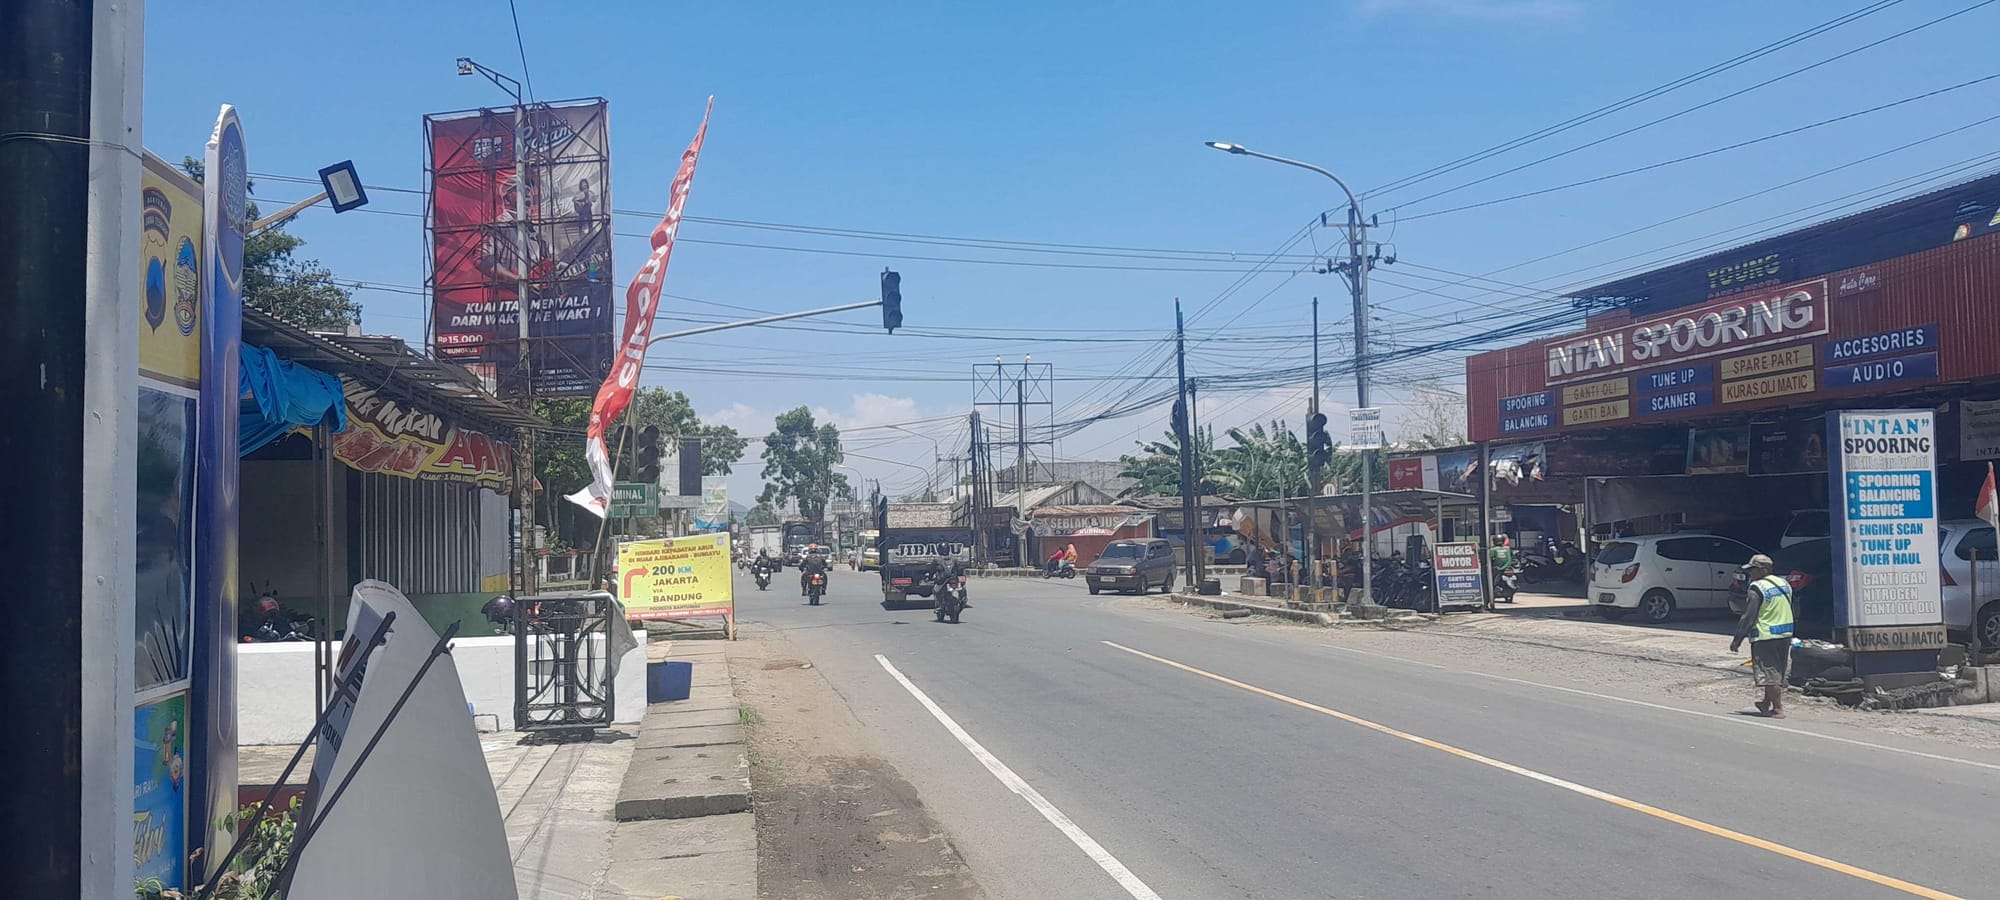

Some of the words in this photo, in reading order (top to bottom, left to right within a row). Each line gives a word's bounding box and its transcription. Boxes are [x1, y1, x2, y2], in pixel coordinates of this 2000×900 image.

[1708, 254, 1780, 289] YOUNG
[465, 300, 520, 314] KUALITA
[530, 295, 590, 310] MENYALA
[451, 314, 481, 327] DARI
[1550, 332, 1625, 377] INTAN
[1632, 290, 1814, 361] SPOORING
[1833, 329, 1924, 358] ACCESORIES
[1733, 355, 1769, 375] SPARE
[1771, 351, 1800, 369] PART
[1651, 370, 1676, 388] TUNE
[1680, 368, 1695, 384] UP
[1852, 361, 1904, 383] AUDIO
[1573, 384, 1598, 399] GANTI
[1602, 381, 1617, 396] OLI
[1726, 382, 1759, 399] KURAS
[1760, 379, 1777, 395] OLI
[1777, 374, 1808, 392] MATIC
[1506, 393, 1545, 411] SPOORING
[1651, 391, 1697, 411] SCANNER
[1572, 406, 1598, 422] GANTI
[1599, 401, 1618, 418] BAN
[1504, 414, 1548, 431] BALANCING
[1844, 437, 1930, 454] SPOORING
[1858, 474, 1921, 488] SPOORING
[1859, 488, 1921, 502] BALANCING
[1860, 503, 1905, 517] SERVICE
[1050, 516, 1088, 529] SEBLAK
[1091, 516, 1099, 526] &
[1101, 516, 1119, 528] JUS
[1860, 523, 1892, 536] ENGINE
[1896, 522, 1924, 535] SCAN
[895, 543, 964, 558] JIBAU
[1437, 545, 1475, 556] BENGKEL
[1860, 539, 1892, 551] TUNE
[1895, 538, 1912, 550] UP
[1441, 557, 1473, 567] MOTOR
[1860, 553, 1890, 566] OVER
[1892, 552, 1921, 565] HAUL
[652, 565, 675, 576] 200
[1863, 572, 1899, 585] GANTI
[1901, 570, 1927, 584] BAN
[652, 576, 699, 587] JAKARTA
[652, 592, 703, 603] BANDUNG
[1863, 587, 1919, 600] NITROGEN
[1864, 602, 1895, 615] GANTI
[1853, 632, 1889, 647] KURAS
[1891, 632, 1912, 645] OLI
[1912, 631, 1944, 645] MATIC
